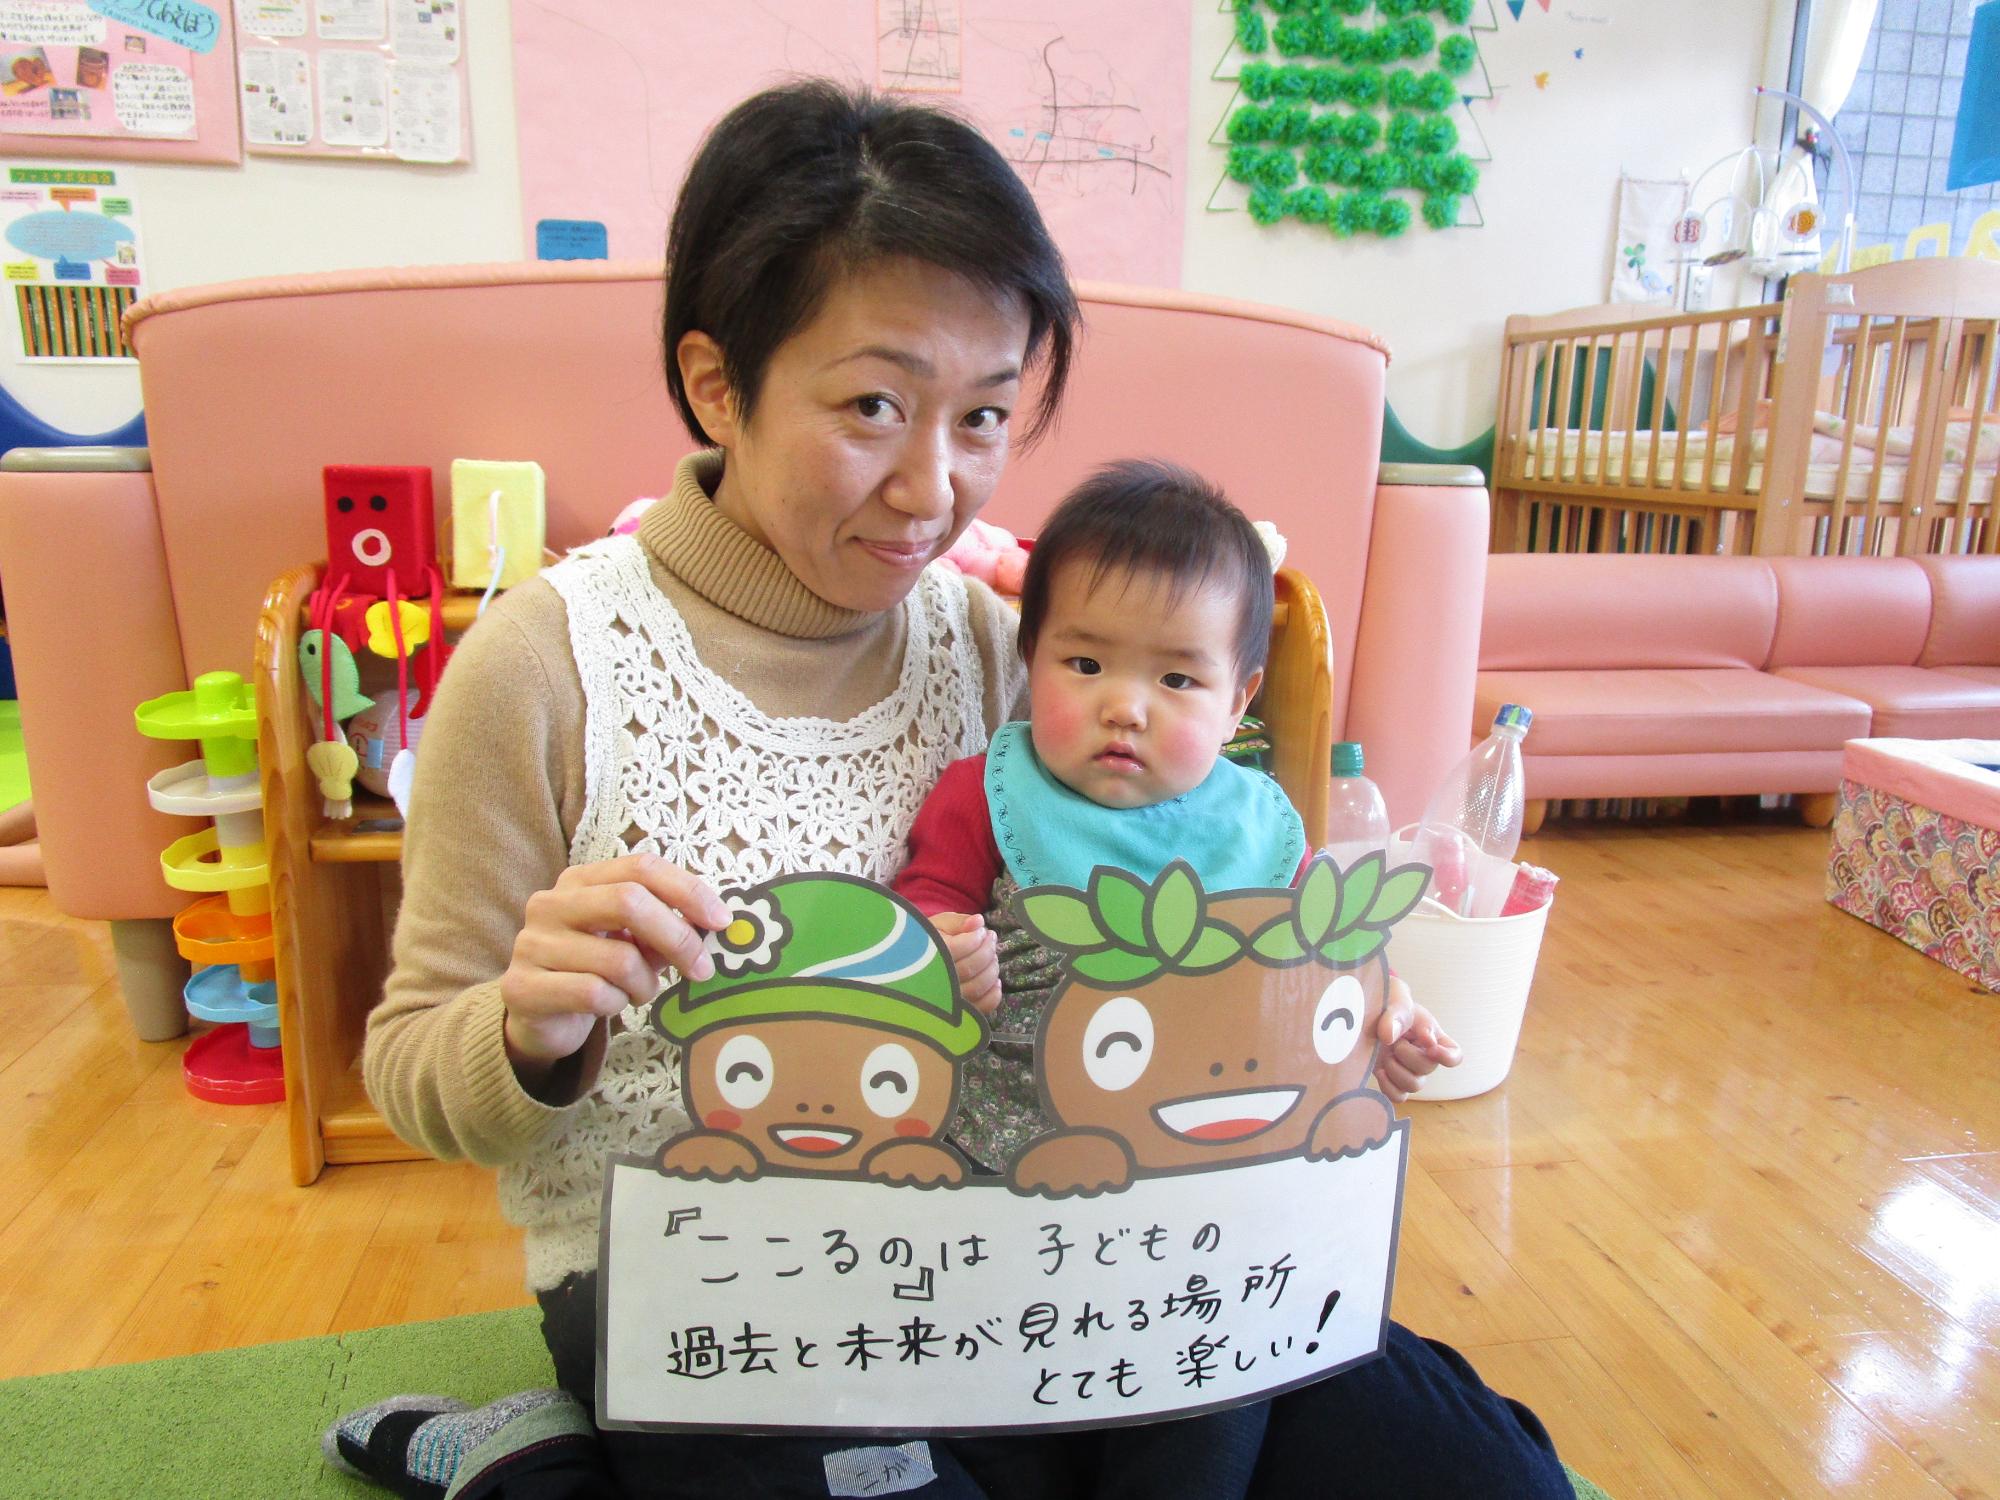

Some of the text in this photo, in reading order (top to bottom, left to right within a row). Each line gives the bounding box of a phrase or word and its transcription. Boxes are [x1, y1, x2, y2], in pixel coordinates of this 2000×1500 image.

[1037, 1222, 1222, 1276] 子どもの
[1032, 1357, 1143, 1405] とても
